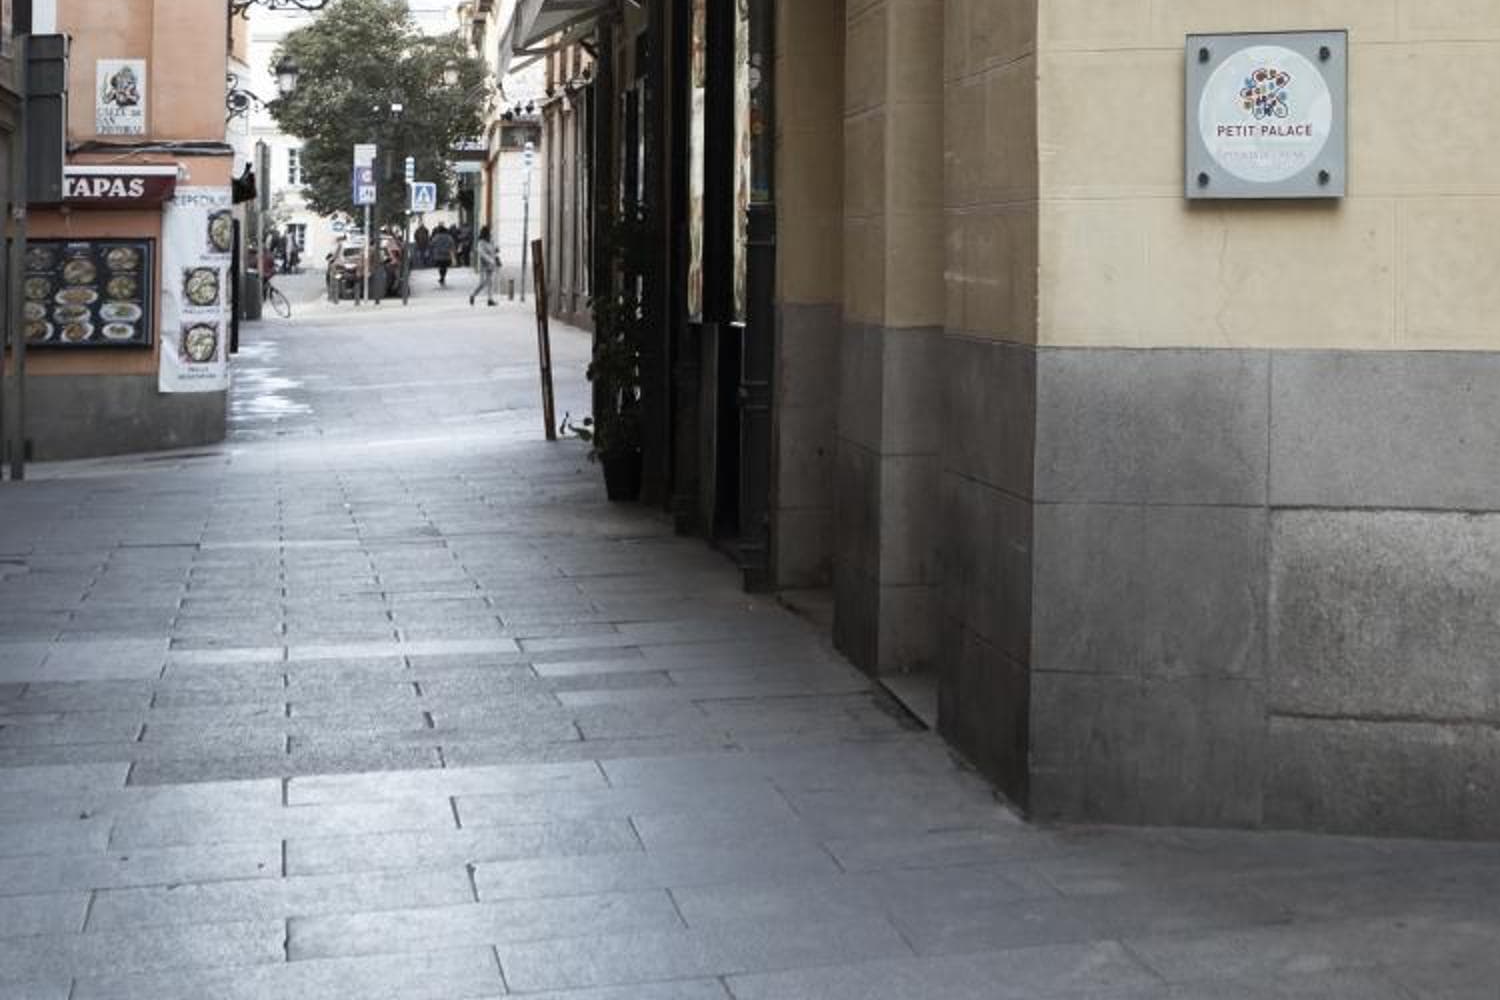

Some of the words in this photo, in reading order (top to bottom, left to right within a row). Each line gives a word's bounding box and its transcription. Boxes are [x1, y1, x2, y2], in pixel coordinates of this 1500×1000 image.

[1217, 125, 1256, 137] PETIT
[1261, 123, 1313, 137] PALACE
[64, 177, 145, 197] TAPAS
